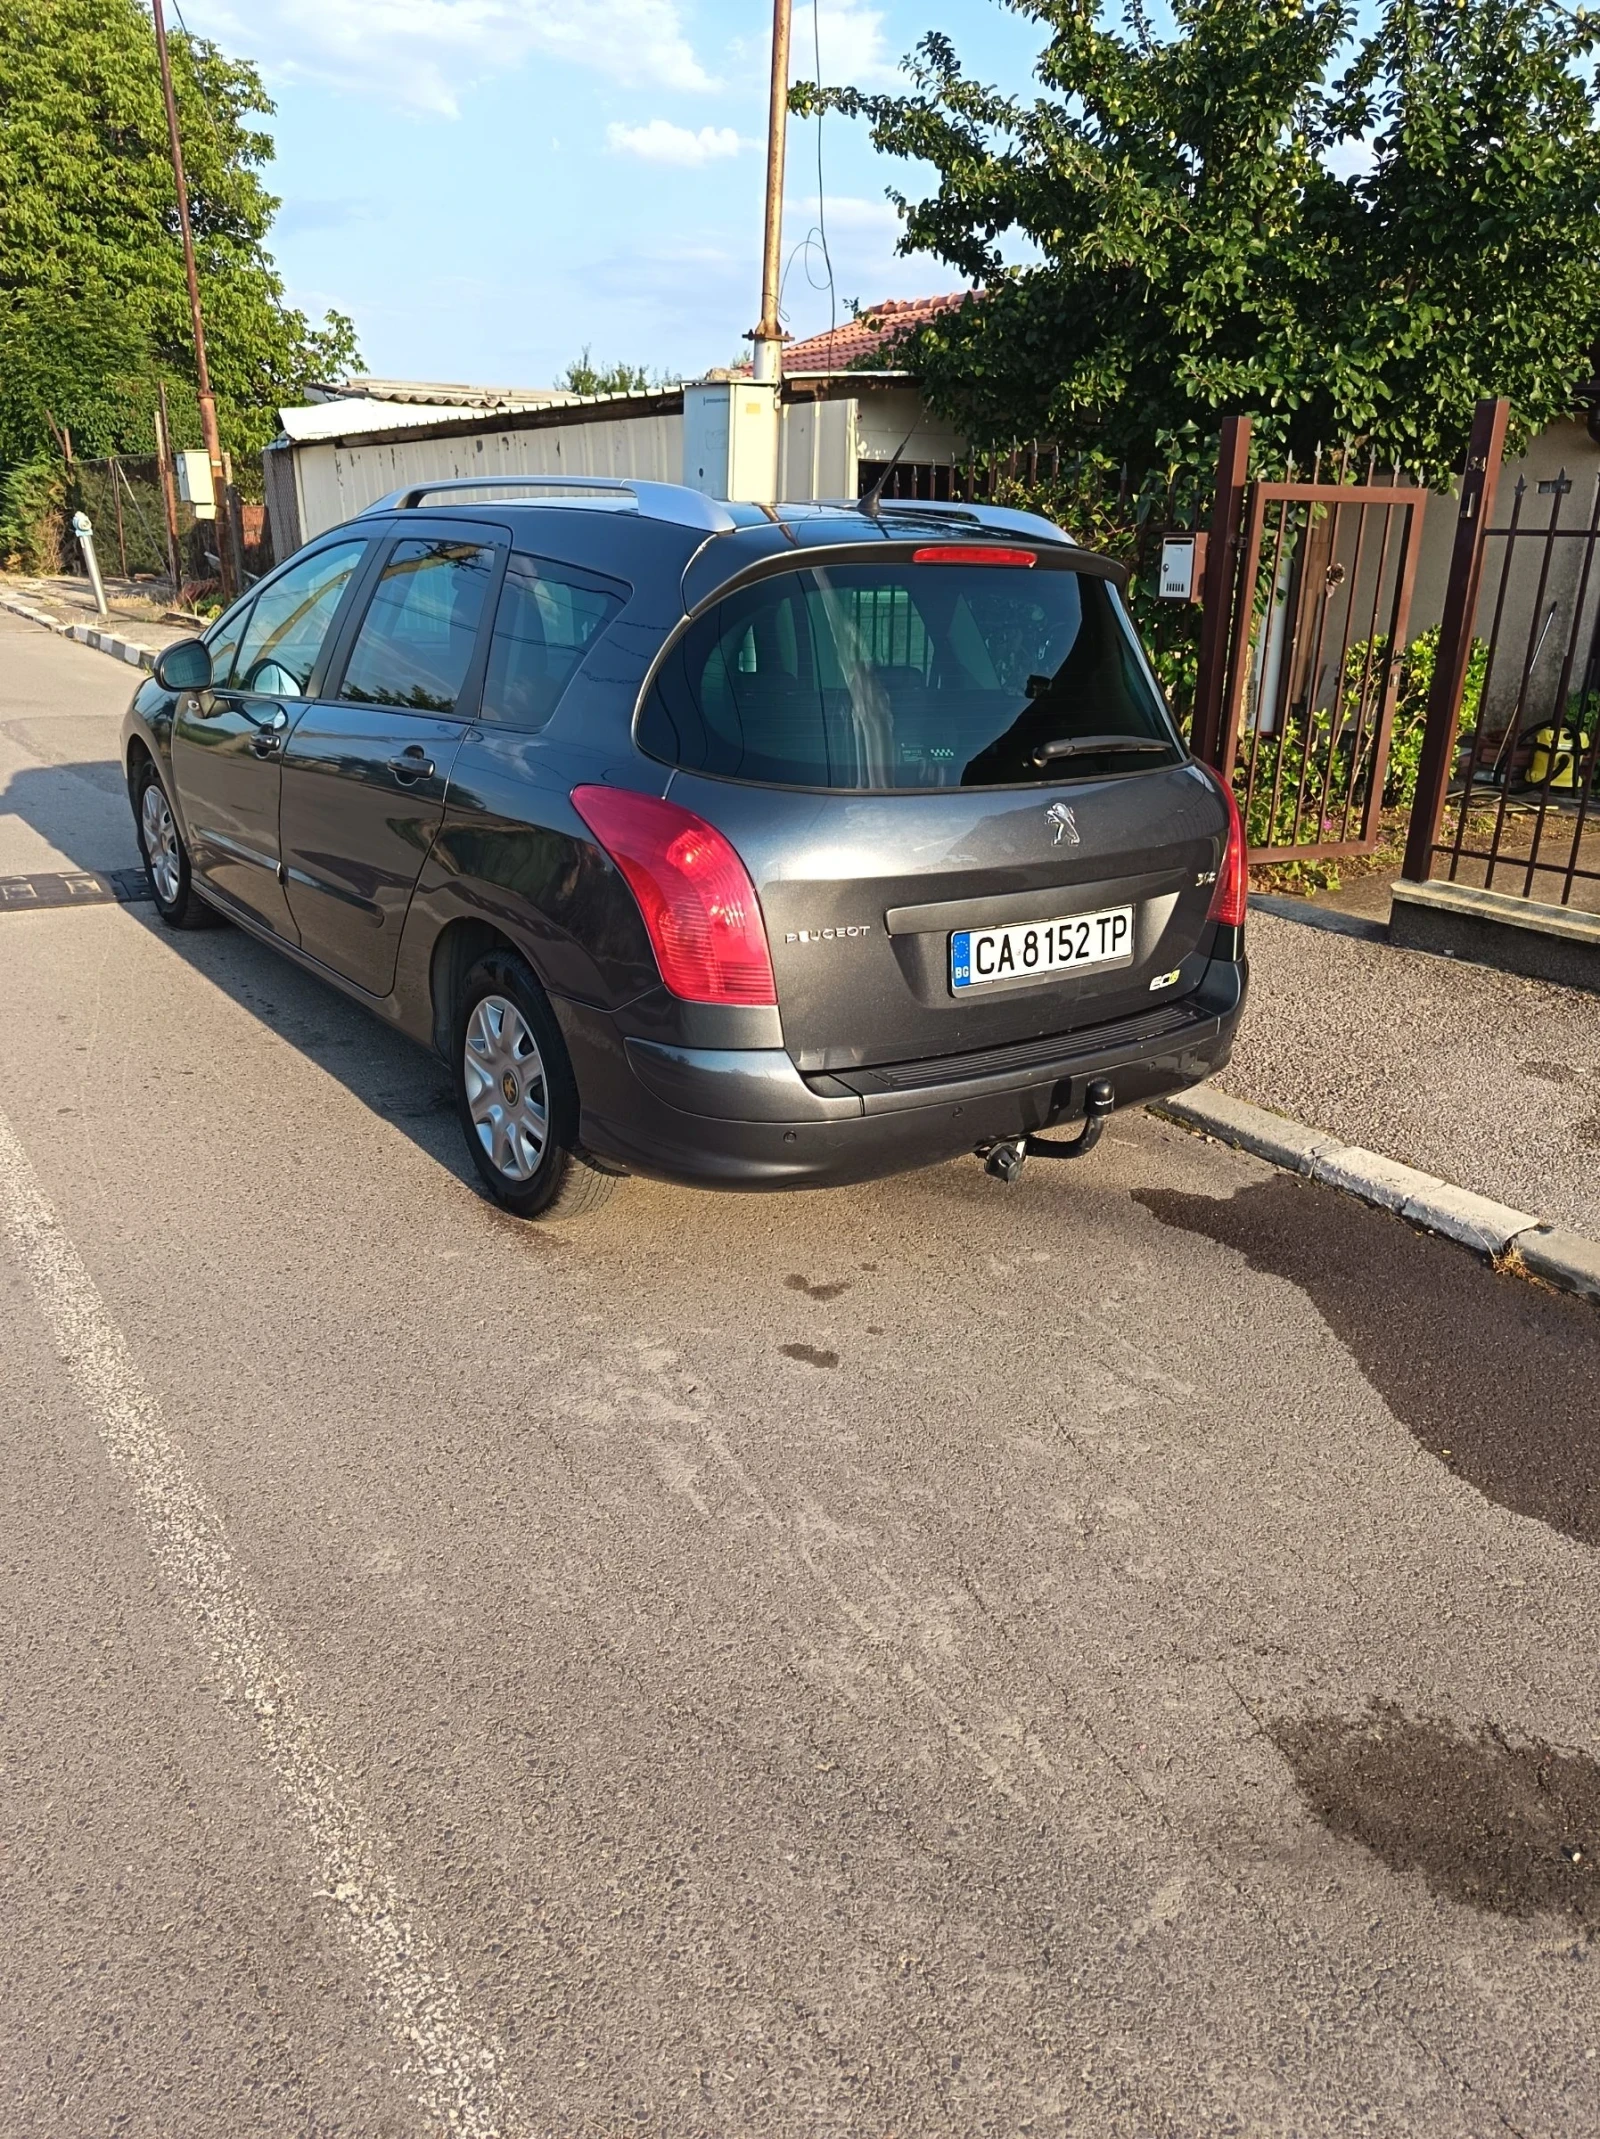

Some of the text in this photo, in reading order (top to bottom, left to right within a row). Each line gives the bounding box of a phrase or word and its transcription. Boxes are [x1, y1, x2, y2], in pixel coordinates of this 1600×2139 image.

[785, 925, 871, 944] PEUGEOT
[976, 914, 1127, 975] CA 8152 TP
[955, 965, 969, 979] BG
